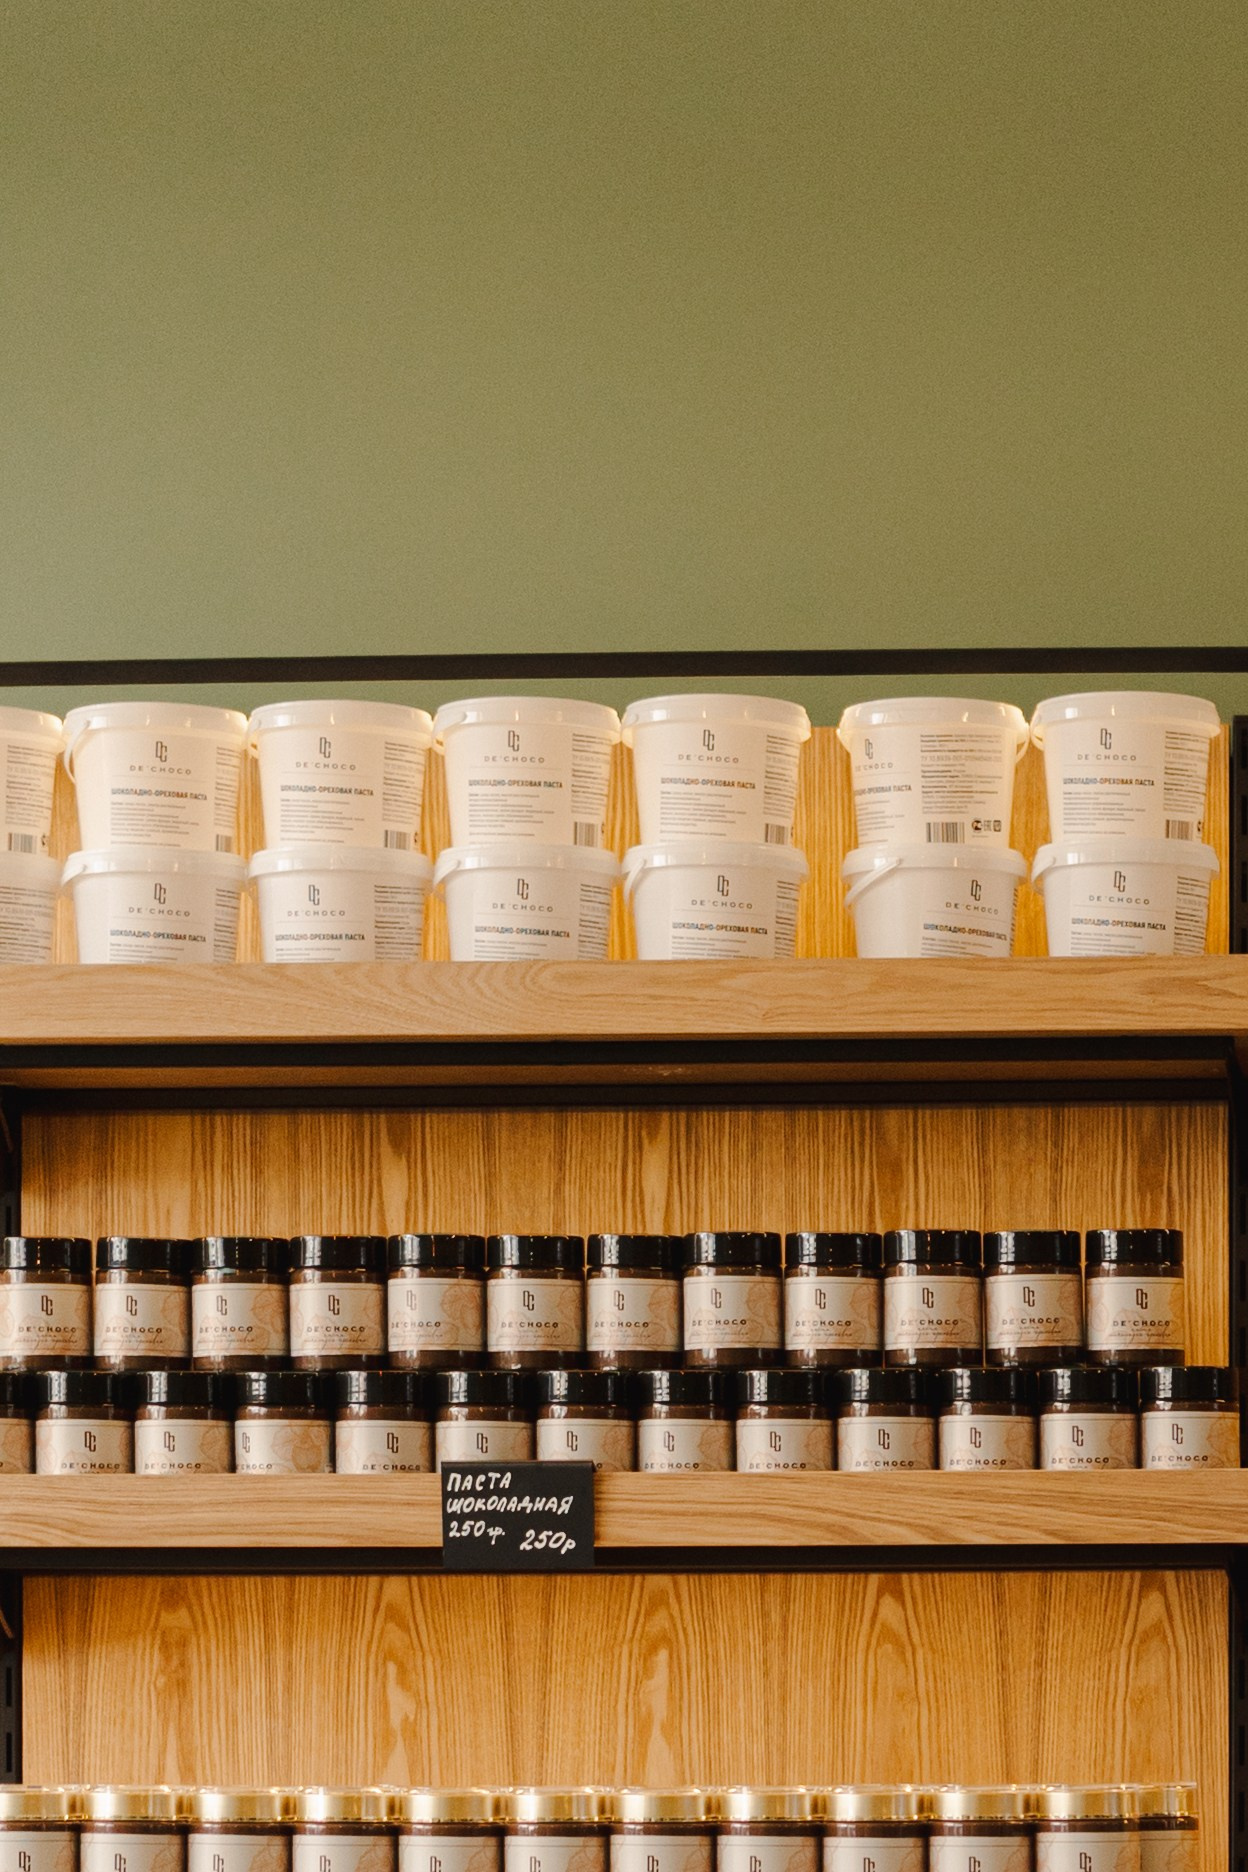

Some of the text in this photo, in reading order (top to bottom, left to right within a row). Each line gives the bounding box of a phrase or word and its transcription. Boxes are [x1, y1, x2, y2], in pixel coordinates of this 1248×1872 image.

[544, 780, 562, 789] ПАСТА
[737, 780, 755, 790] ПАСТА
[1135, 778, 1154, 787] ПАСТА
[190, 791, 207, 801] ПАСТА
[354, 787, 374, 797] ПАСТА
[1147, 921, 1166, 931] ПАСТА
[189, 933, 206, 943] ПАСТА
[447, 1472, 512, 1492] ПАСТА
[446, 1496, 573, 1515] ШОКОЛАДНАЯ
